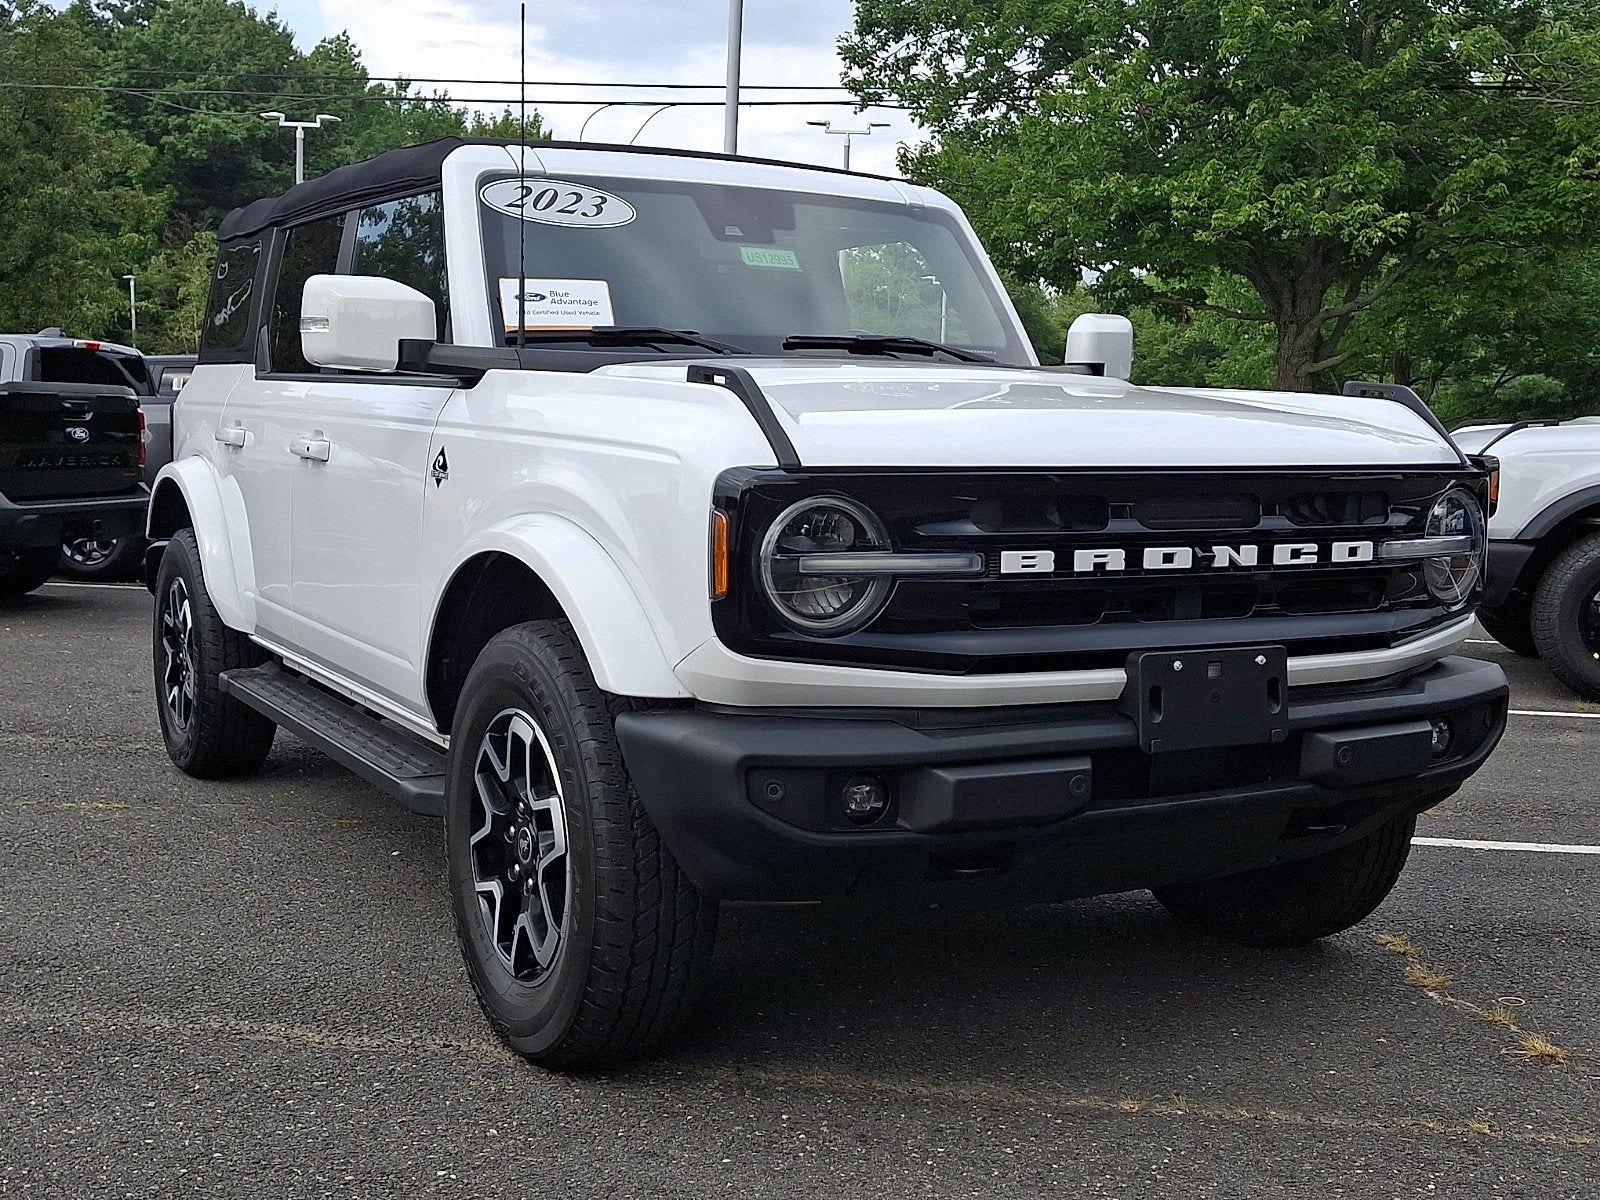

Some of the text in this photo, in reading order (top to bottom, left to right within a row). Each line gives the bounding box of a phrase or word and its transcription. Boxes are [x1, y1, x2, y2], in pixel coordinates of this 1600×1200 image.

[503, 185, 608, 218] 2023
[549, 290, 570, 298] Blue
[550, 298, 599, 307] Advantage
[1000, 541, 1374, 573] BRONCO
